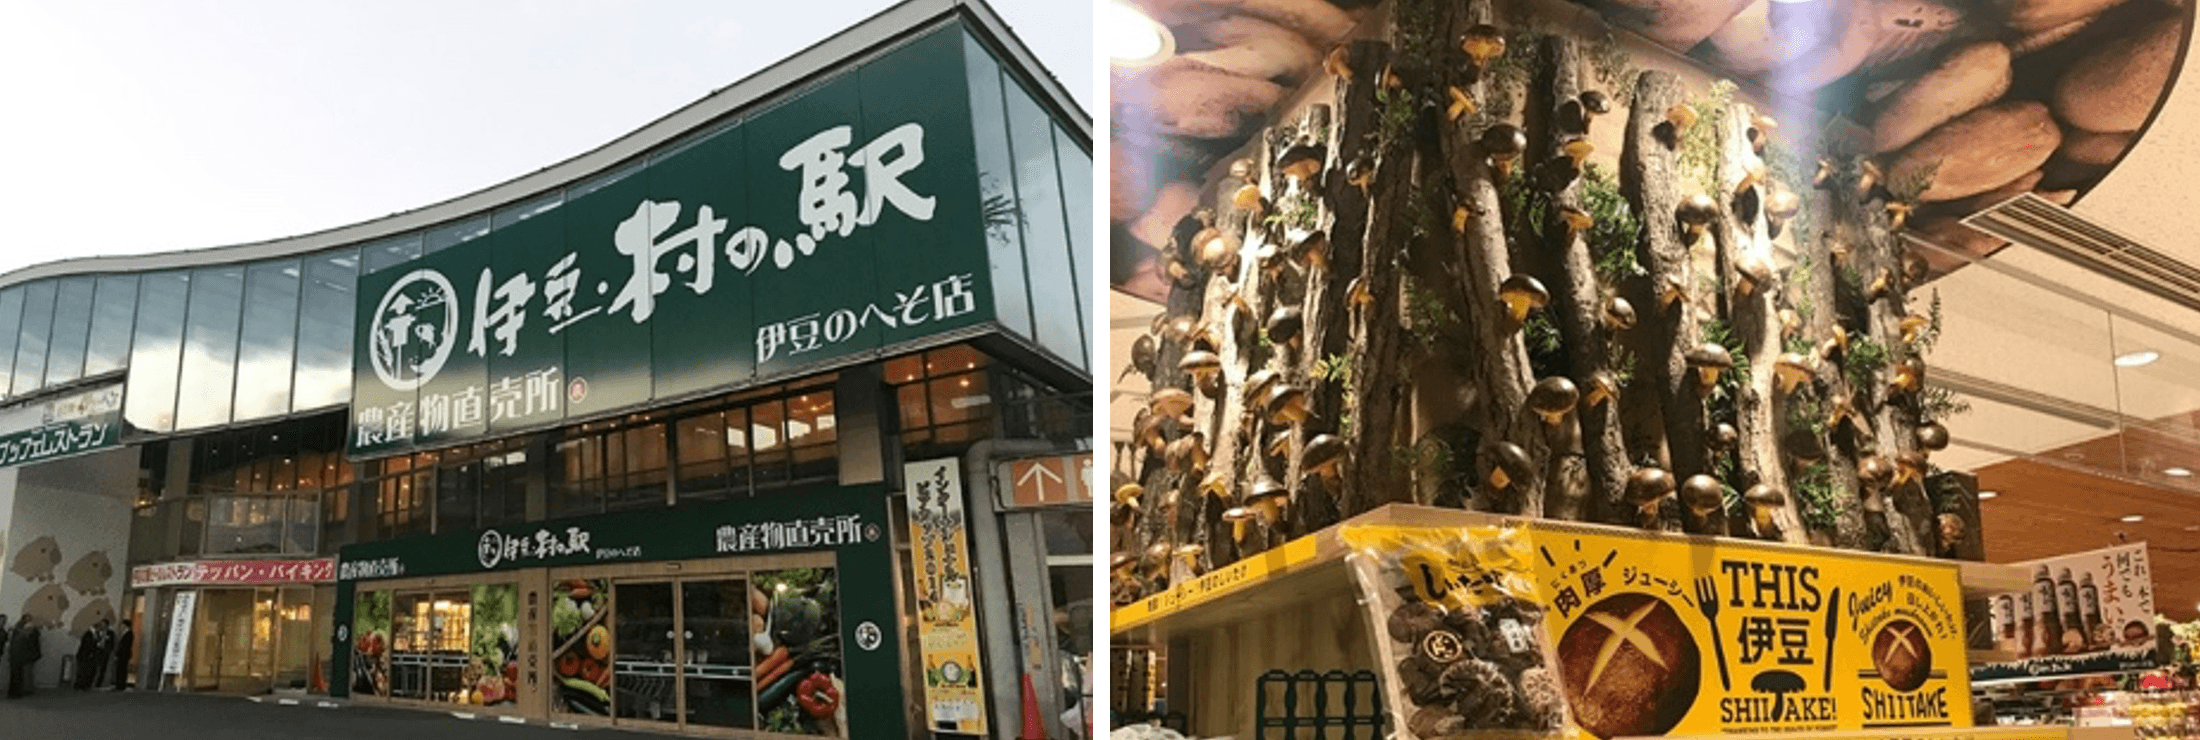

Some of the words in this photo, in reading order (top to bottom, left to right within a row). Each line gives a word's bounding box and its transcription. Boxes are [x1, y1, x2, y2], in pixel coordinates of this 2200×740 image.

[467, 123, 936, 358] 伊豆・村の駅
[756, 273, 976, 364] 伊豆のへそ店
[356, 366, 560, 449] 農産物直売所
[715, 514, 862, 552] 農産物直売所
[1554, 567, 1606, 618] 肉厚
[1623, 566, 1694, 607] ジューシー
[1721, 560, 1821, 612] THIS
[1737, 616, 1814, 665] 伊豆
[1862, 686, 1949, 719] SHIITAKE
